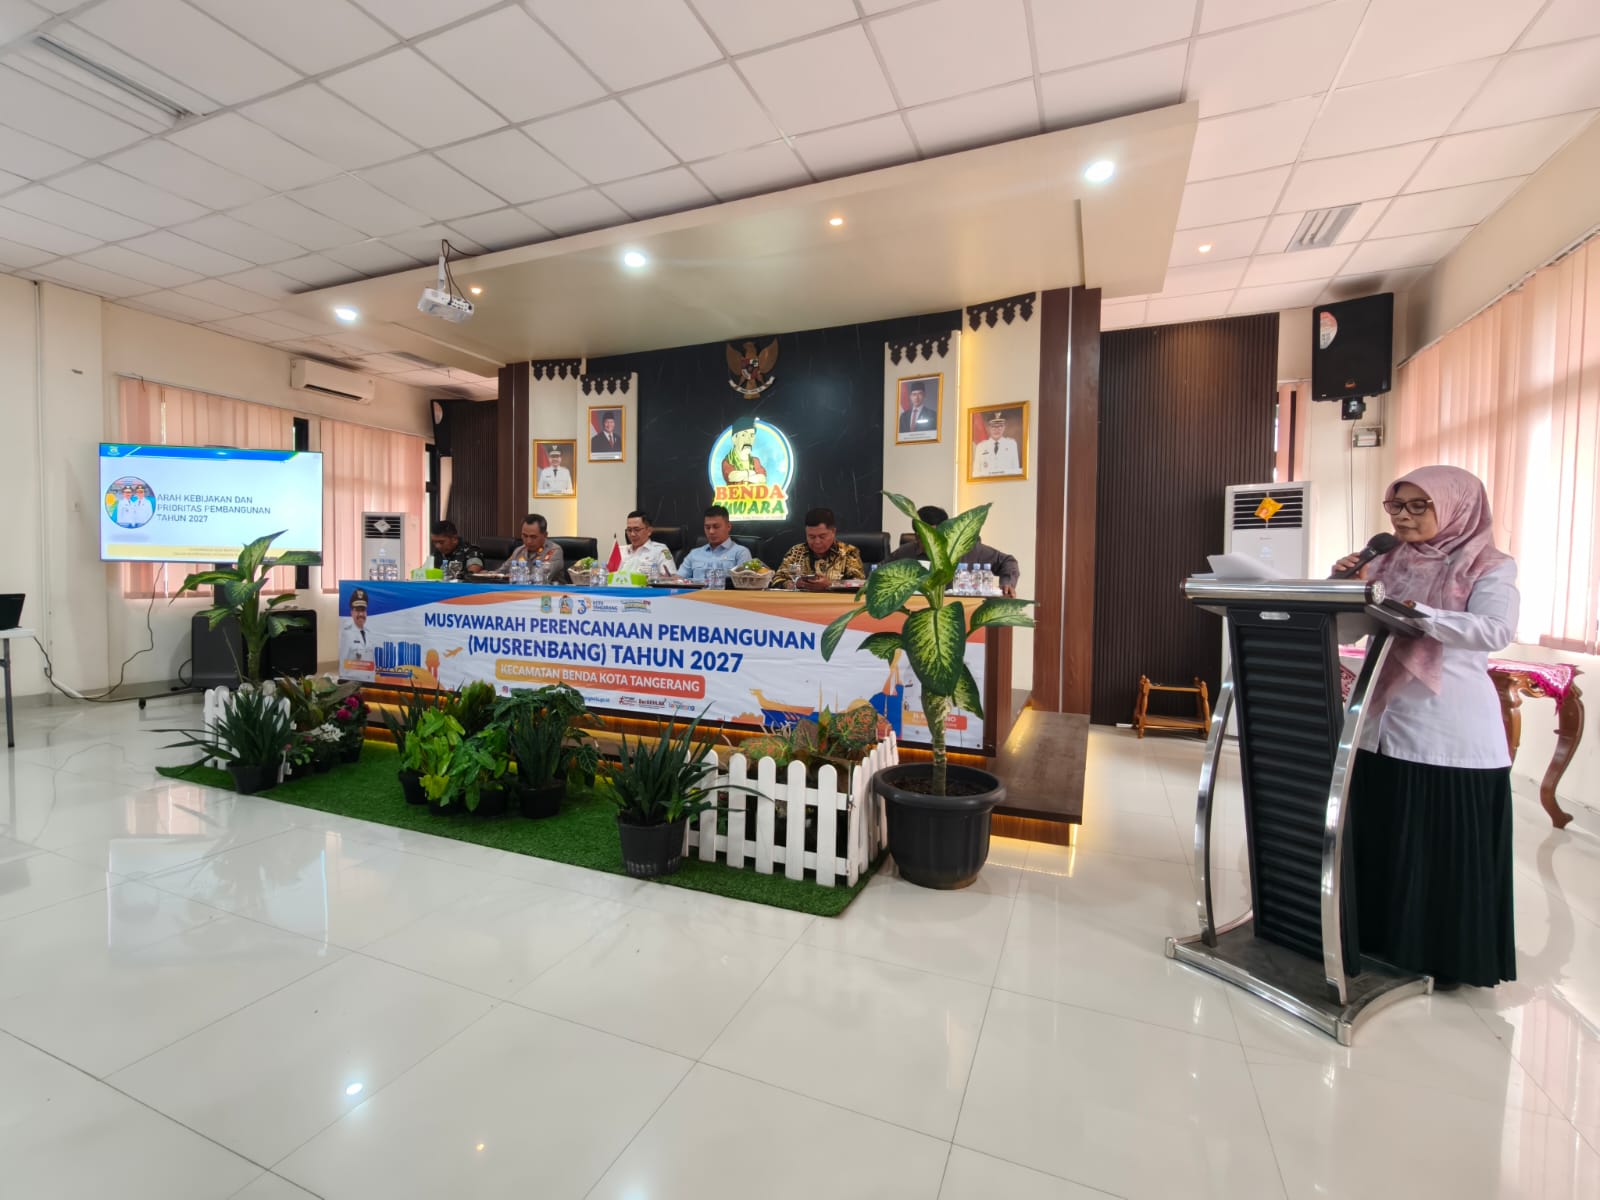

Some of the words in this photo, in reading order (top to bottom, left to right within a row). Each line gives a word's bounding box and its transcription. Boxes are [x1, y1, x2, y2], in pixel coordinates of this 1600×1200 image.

[157, 493, 182, 502] ARAH
[183, 494, 233, 503] KEBIJAKAN
[234, 496, 253, 504] DAN
[715, 484, 784, 501] BENDA
[157, 504, 202, 513] PRIORITAS
[204, 505, 271, 514] PEMBANGUNAN
[156, 513, 187, 522] TAHUN
[188, 515, 208, 523] 2027
[424, 612, 526, 633] MUSYAWARAH
[529, 618, 653, 640] PERENCANAAN
[658, 624, 816, 650] PEMBANGUNAN
[468, 634, 607, 666] (MUSRENBANG)
[611, 645, 684, 669] TAHUN
[690, 650, 744, 673] 2027
[500, 664, 561, 679] KECAMATAN
[562, 671, 598, 683] BENDA
[599, 673, 628, 686] KOTA
[630, 675, 701, 692] TANGERANG
